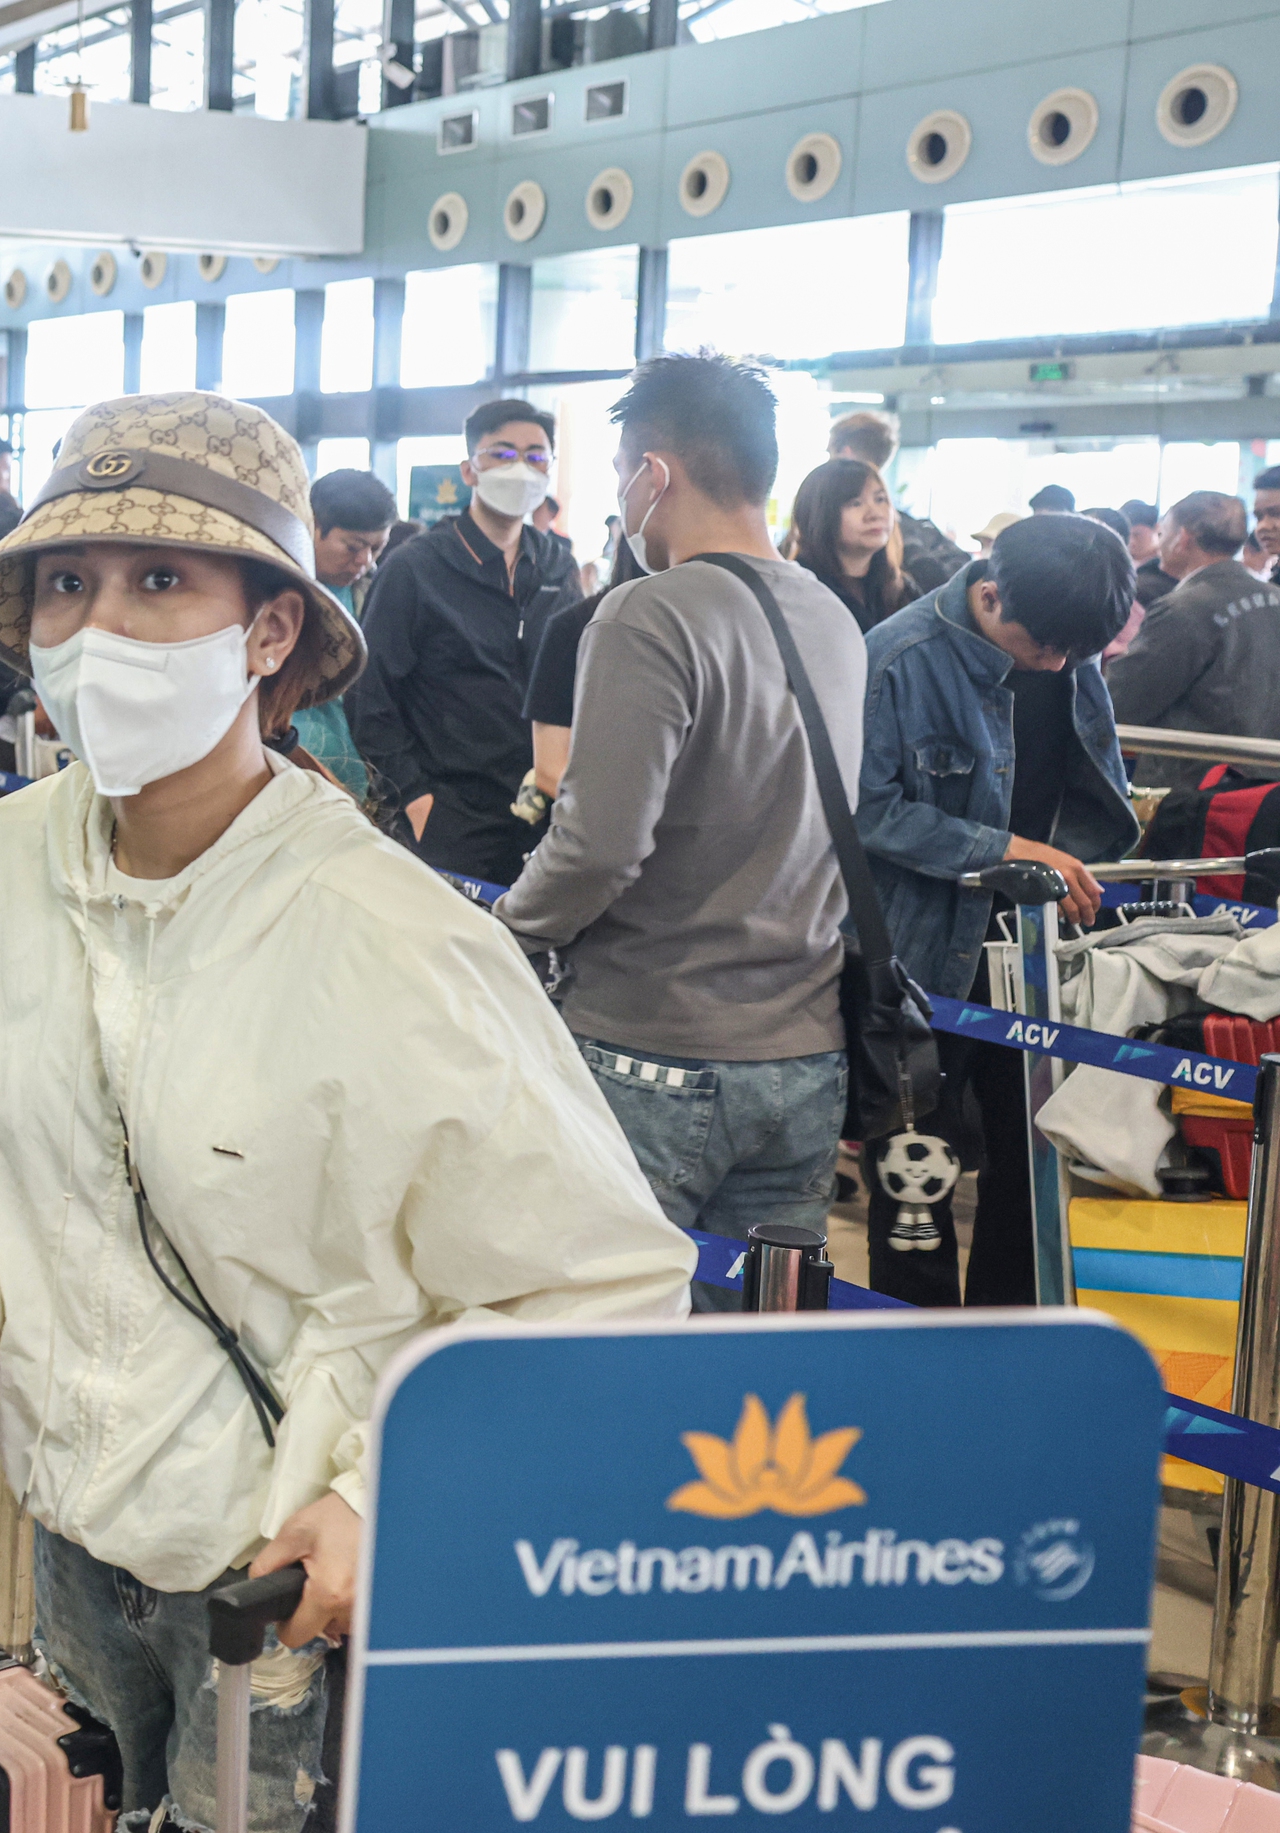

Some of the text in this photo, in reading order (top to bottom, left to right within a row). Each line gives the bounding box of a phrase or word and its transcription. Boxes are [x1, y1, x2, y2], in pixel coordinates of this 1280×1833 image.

[1006, 1020, 1060, 1049] ACV
[1171, 1058, 1235, 1090] ACV
[514, 1537, 774, 1598] Vietnam
[773, 1527, 1005, 1590] Airlines
[495, 1721, 956, 1823] VUI LÒNG
